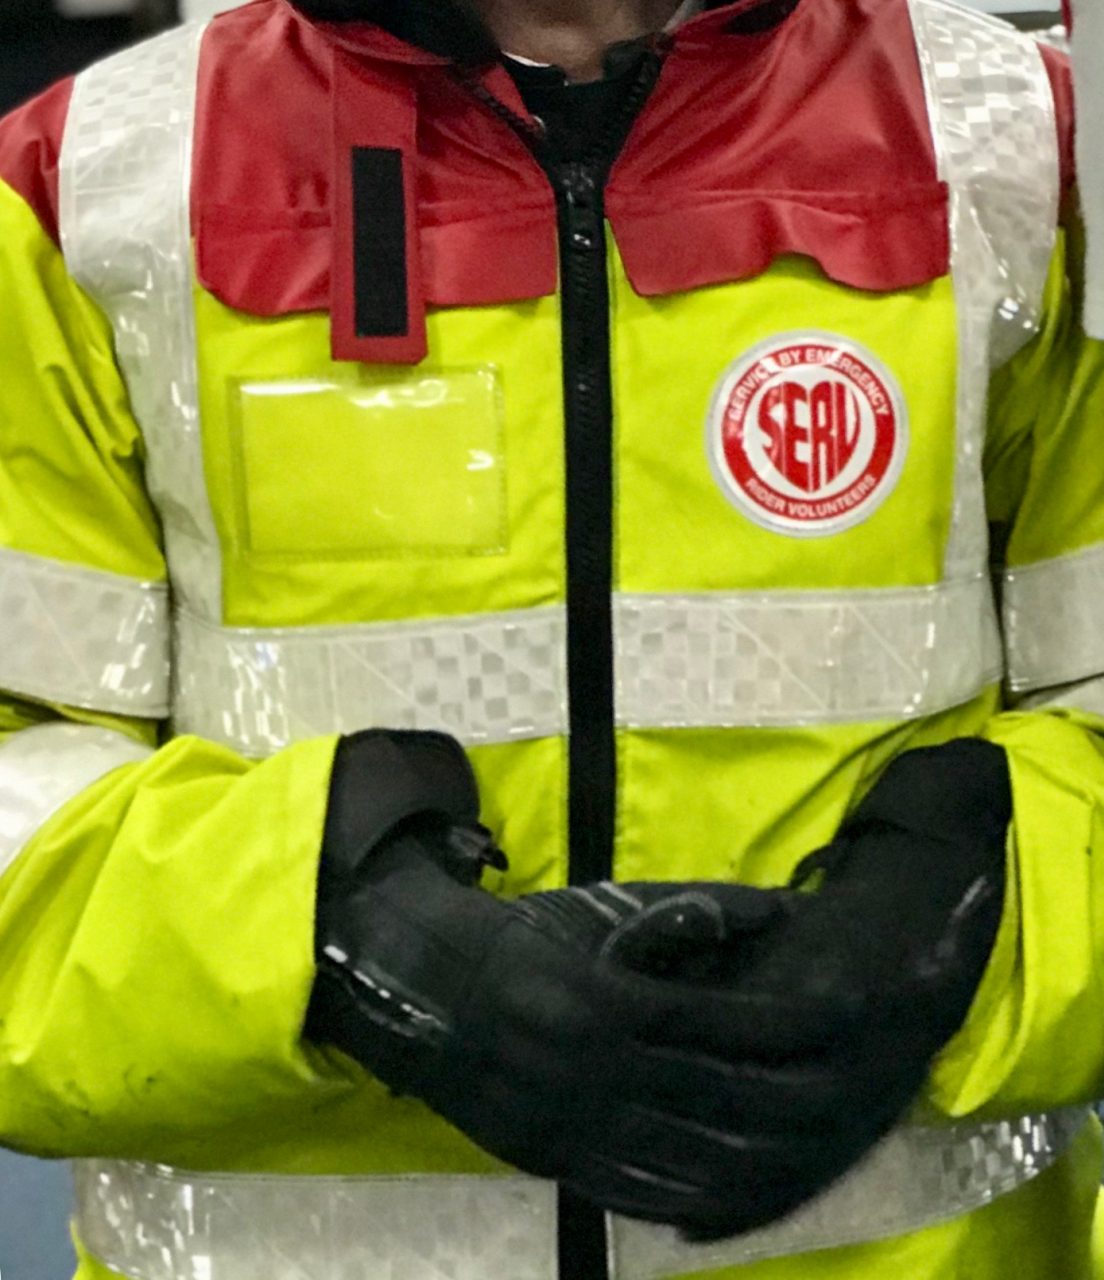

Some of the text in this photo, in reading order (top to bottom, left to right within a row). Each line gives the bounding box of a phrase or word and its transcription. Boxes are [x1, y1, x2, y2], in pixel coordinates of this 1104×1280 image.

[780, 350, 801, 367] BY
[756, 381, 862, 494] SERV
[746, 473, 878, 519] RIDER VOLUNTEERS
